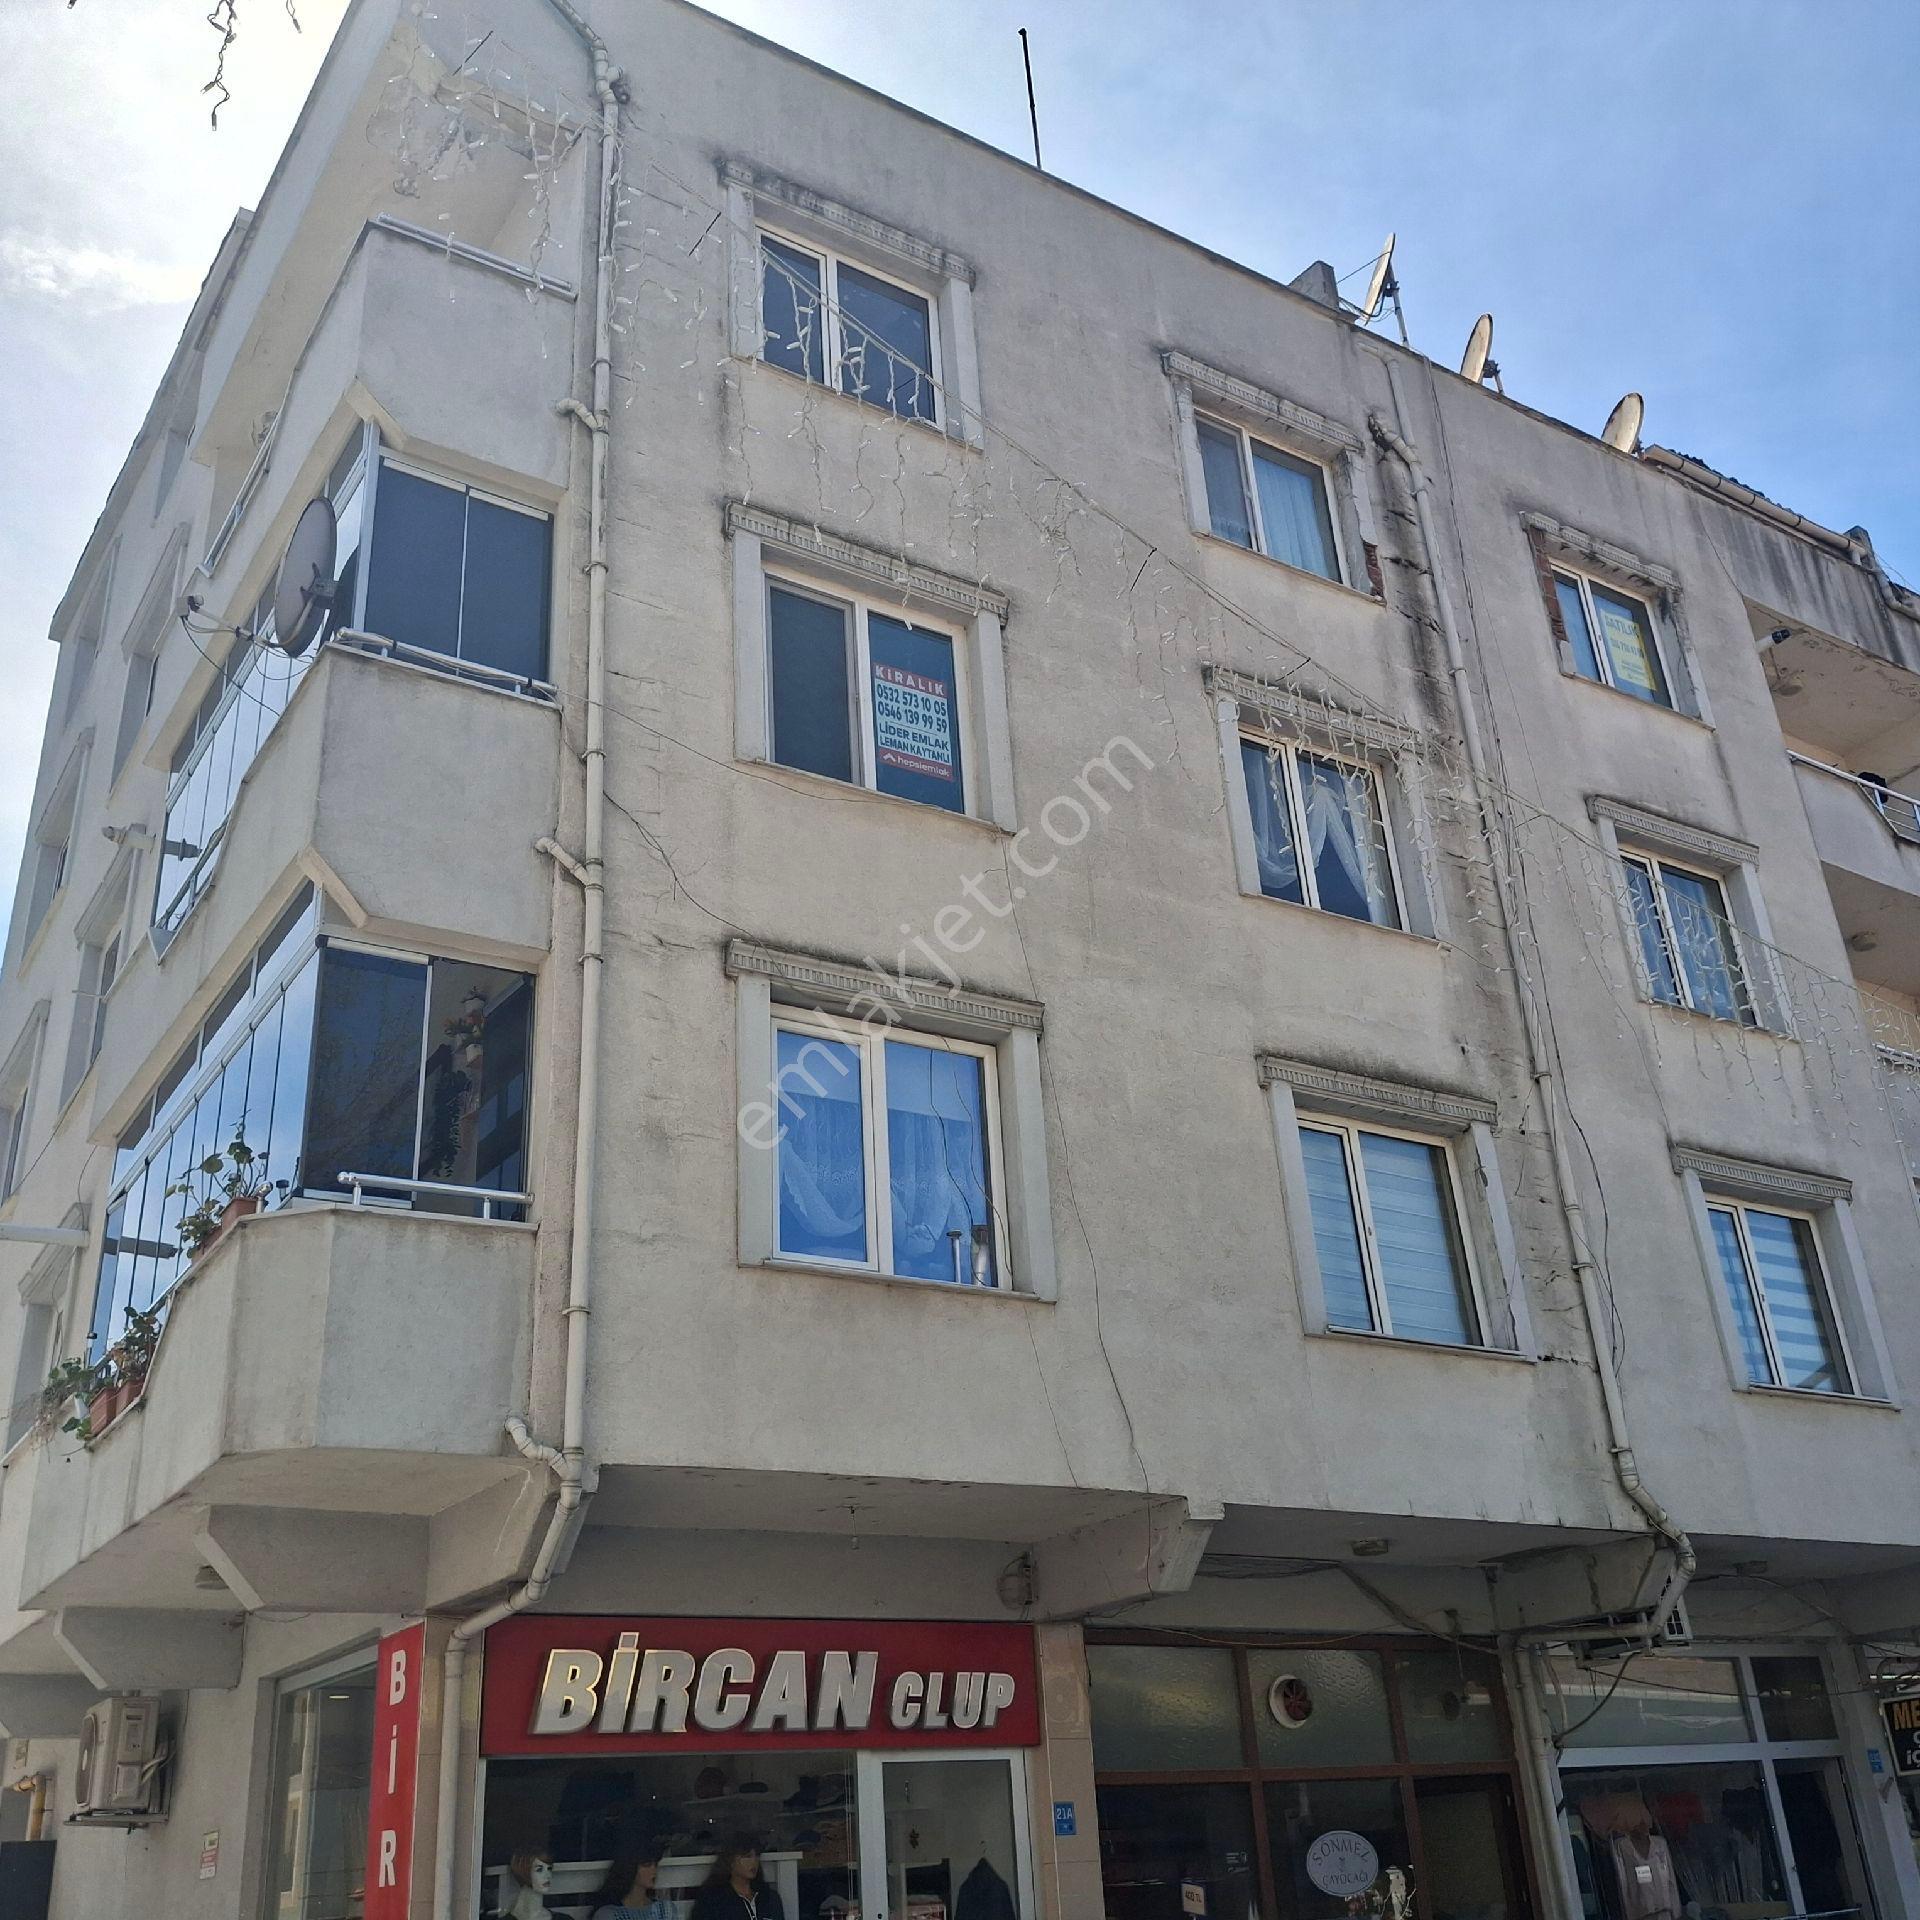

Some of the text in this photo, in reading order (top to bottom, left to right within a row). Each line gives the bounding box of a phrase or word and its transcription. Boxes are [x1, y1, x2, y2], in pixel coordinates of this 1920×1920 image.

[875, 665, 945, 696] KİRALIK
[876, 683, 947, 717] 0532 573 10 05
[877, 702, 948, 734] 0546 139 99 59
[879, 721, 950, 752] LİDER EMLAK
[880, 736, 950, 763] LEMAN KAYTANLI
[897, 755, 950, 777] hepsiemlak
[531, 1631, 1016, 1735] BİRCAN CLUP
[1056, 1807, 1073, 1820] 21A
